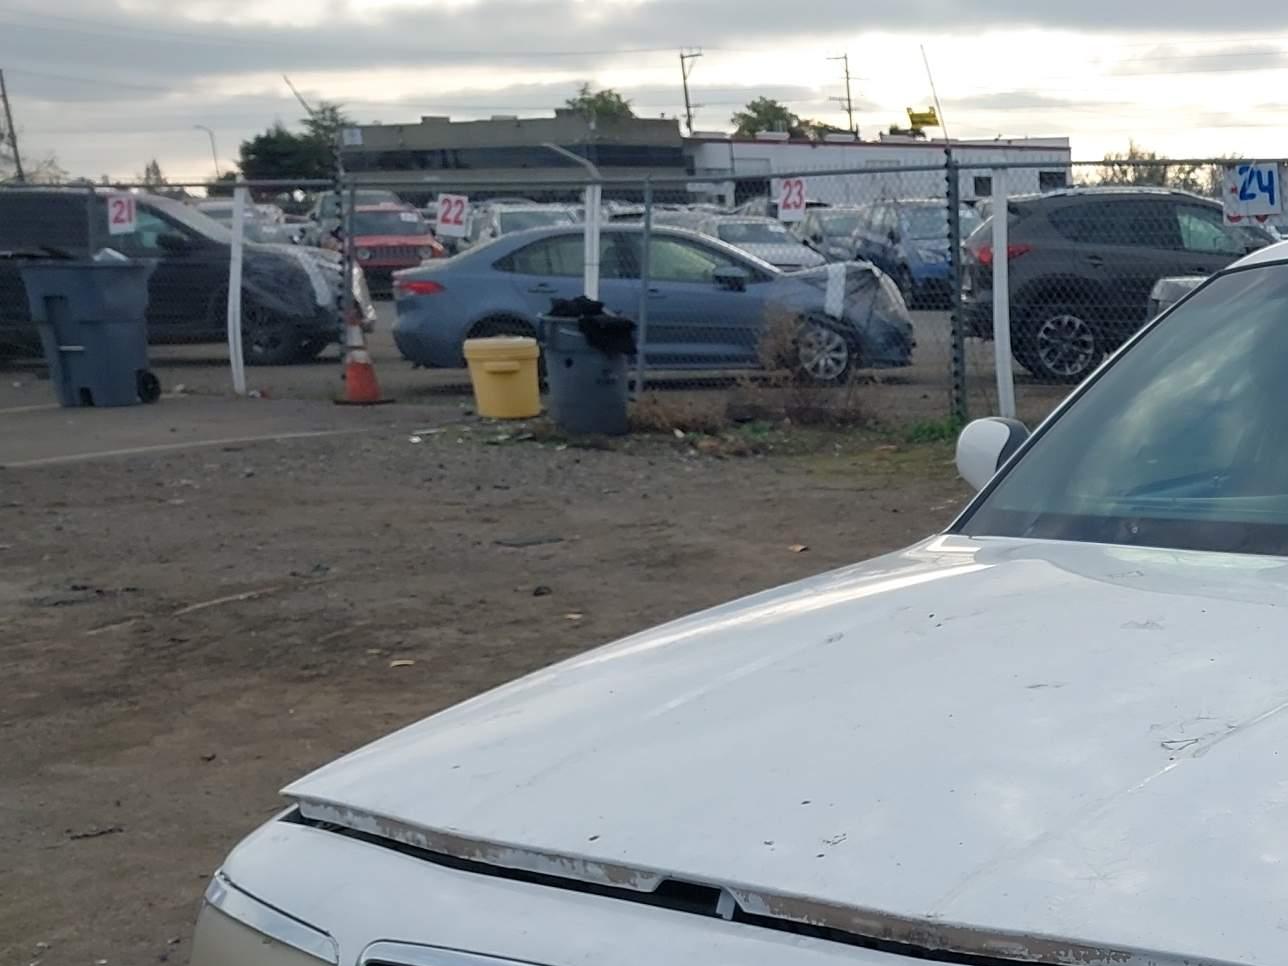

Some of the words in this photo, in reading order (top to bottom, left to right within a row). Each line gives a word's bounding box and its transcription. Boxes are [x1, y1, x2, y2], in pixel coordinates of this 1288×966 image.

[783, 179, 804, 209] 23
[1238, 165, 1276, 206] 24
[112, 199, 133, 224] 21
[441, 198, 465, 225] 22
